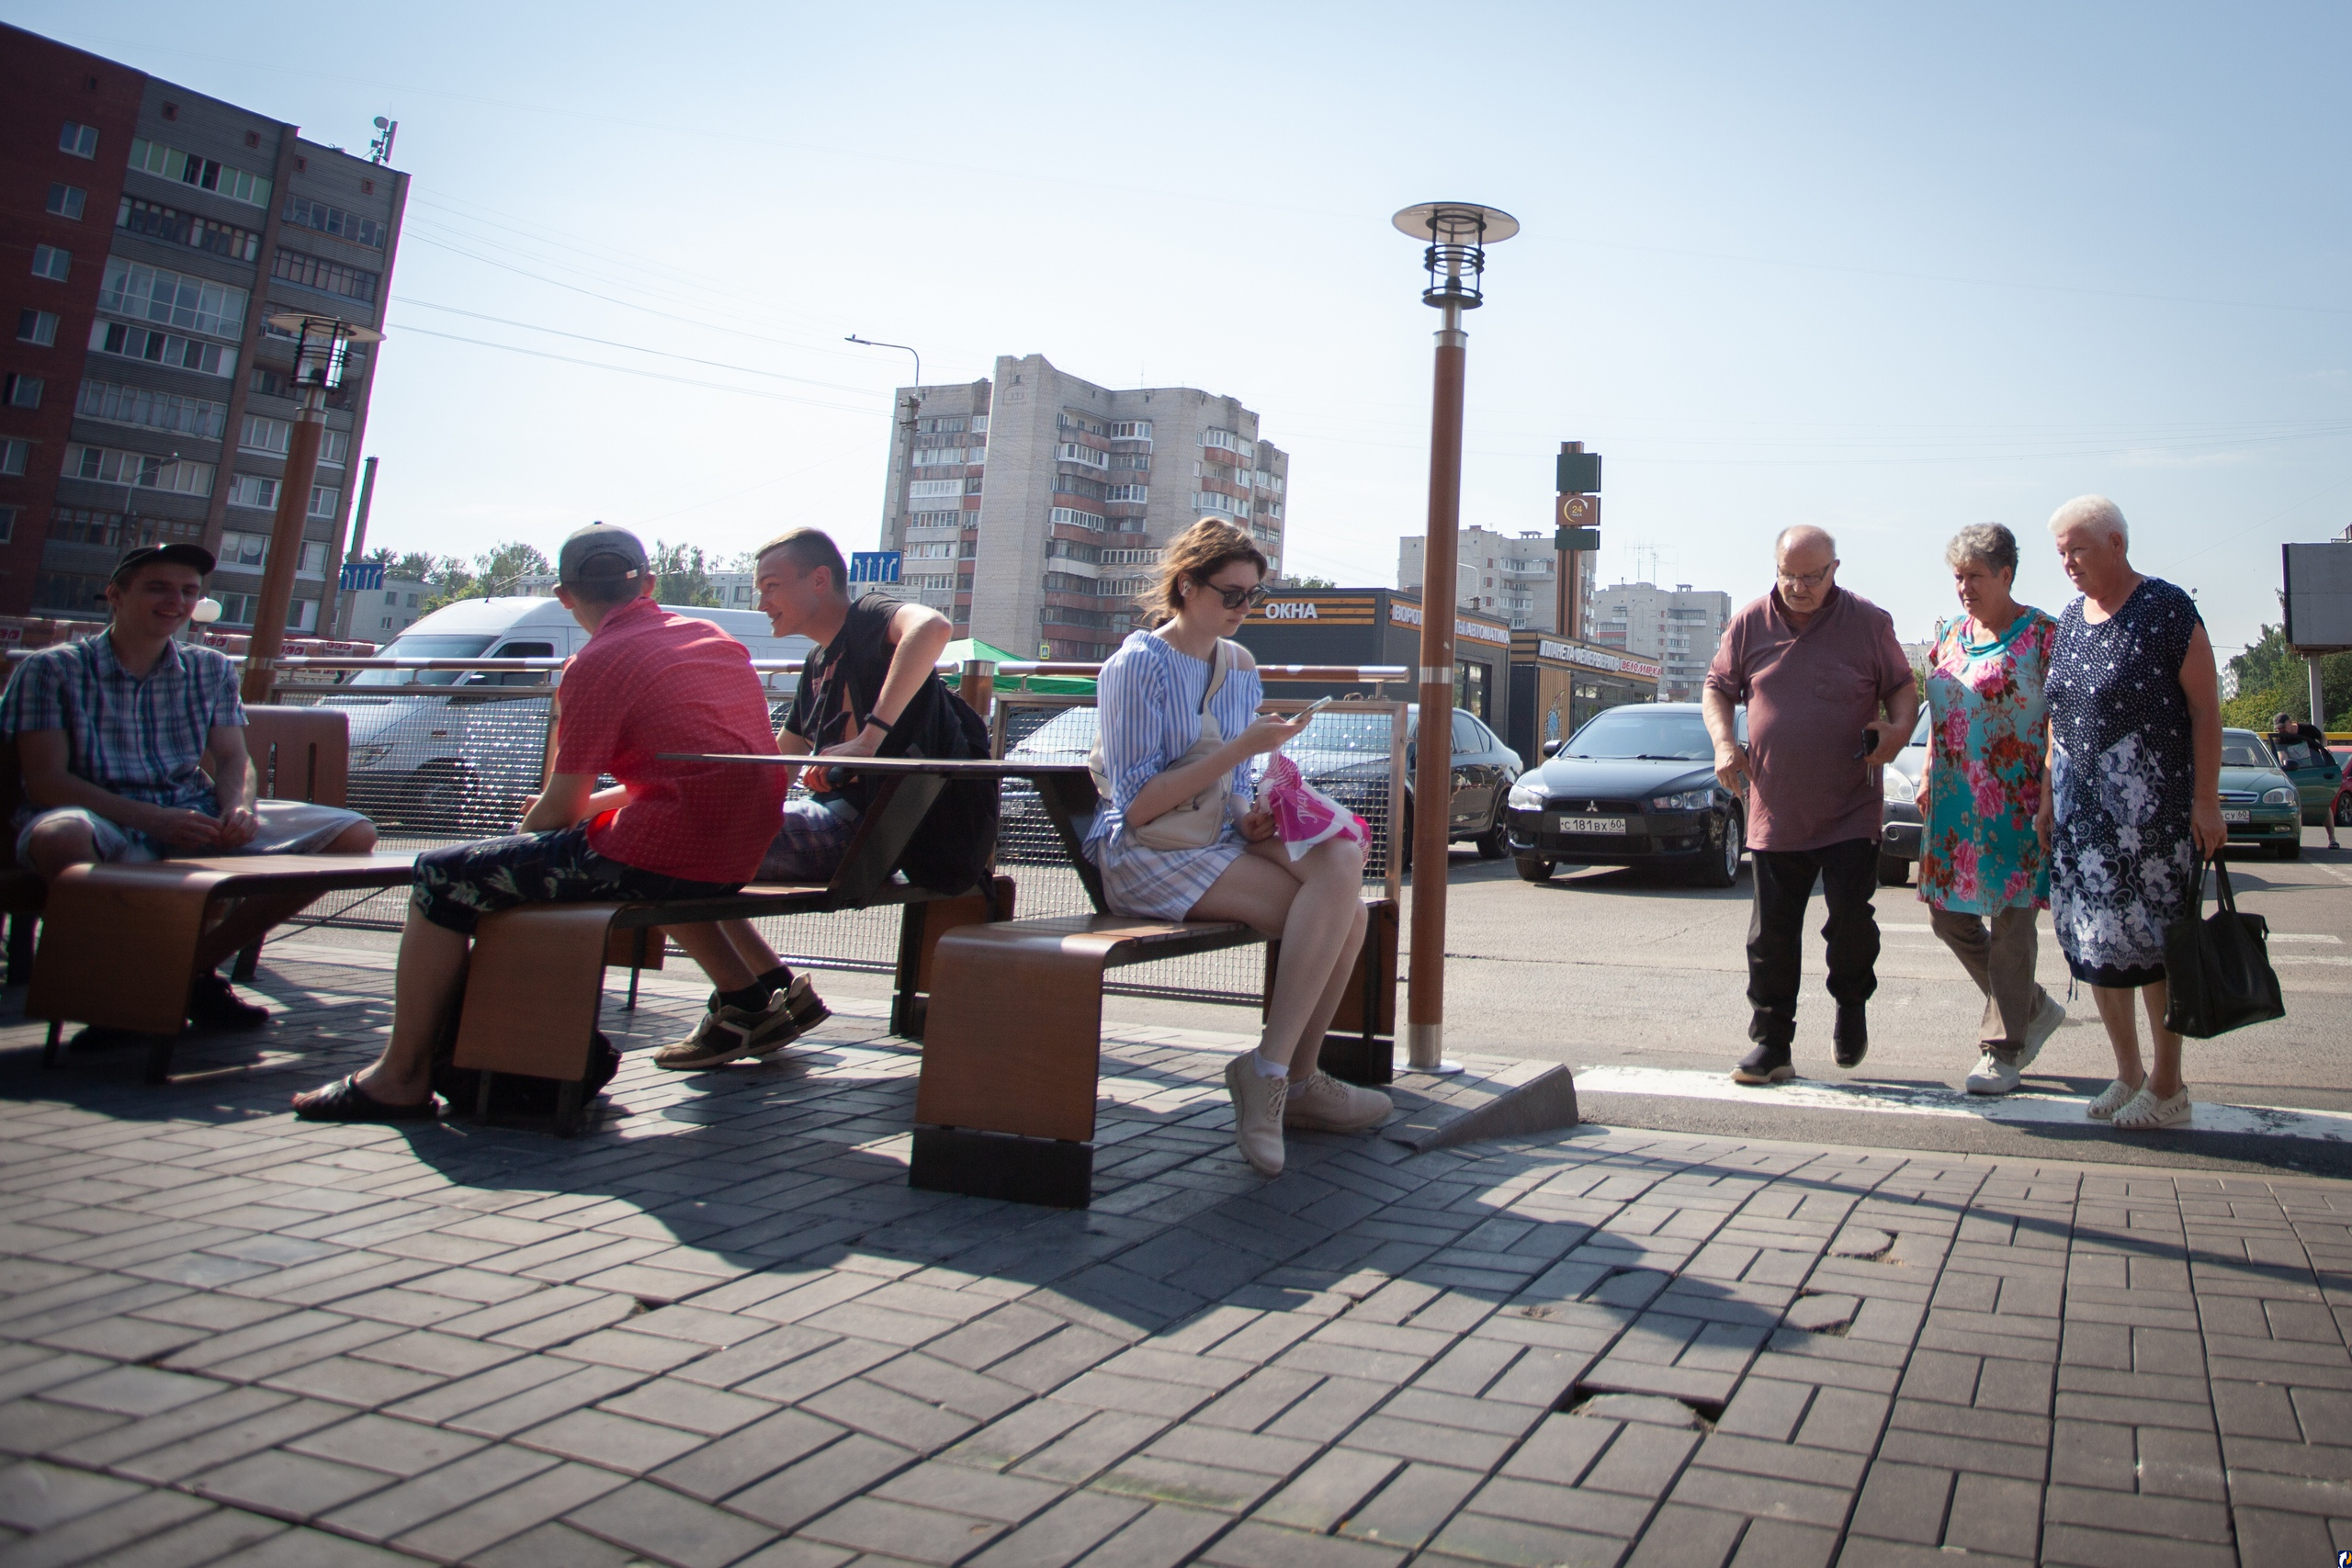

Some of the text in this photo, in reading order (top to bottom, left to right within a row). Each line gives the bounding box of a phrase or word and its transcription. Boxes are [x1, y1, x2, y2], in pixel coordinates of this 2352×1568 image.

[1572, 505, 1582, 513] 24
[1265, 603, 1318, 619] ОКНА
[1392, 604, 1422, 626] ВОРОТ
[1466, 622, 1510, 645] АВТОМАТИКА
[1539, 640, 1575, 662] ПЛАНЕТА
[1610, 819, 1622, 829] 60
